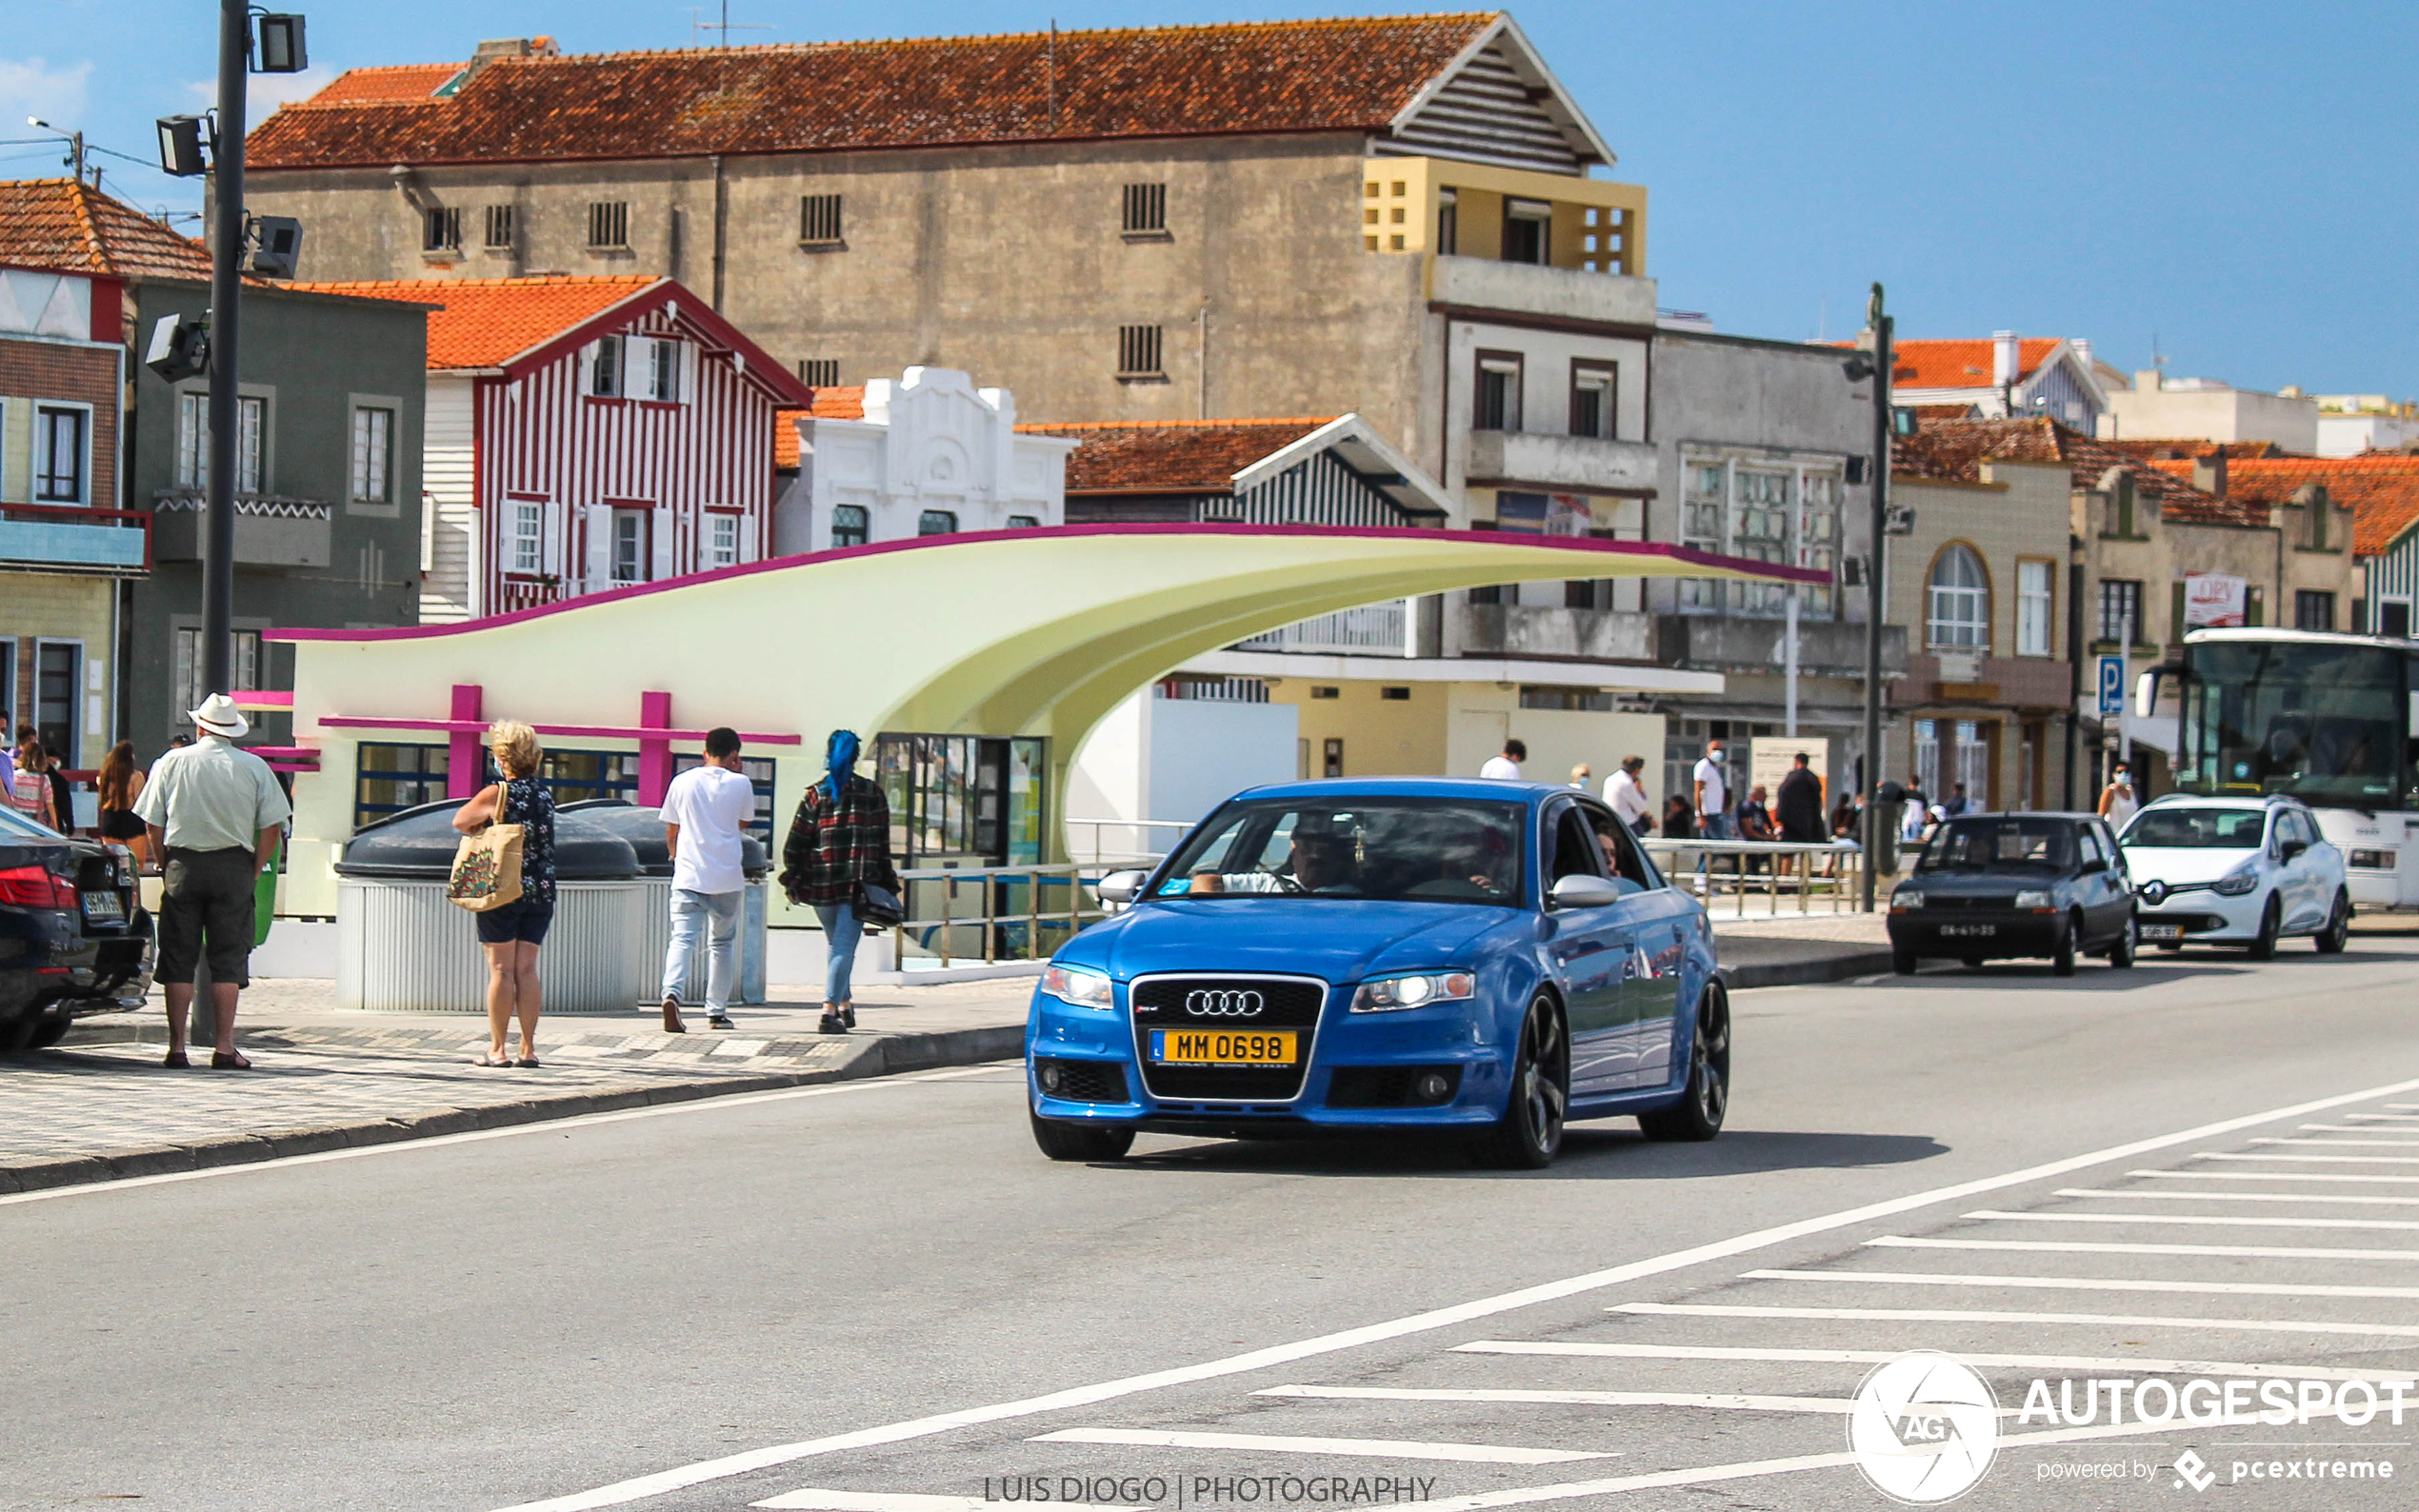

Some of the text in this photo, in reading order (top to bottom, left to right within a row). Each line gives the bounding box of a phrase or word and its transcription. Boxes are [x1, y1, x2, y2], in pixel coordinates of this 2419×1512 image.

[2104, 662, 2119, 708] P
[1153, 1048, 1161, 1057] L
[1177, 1035, 1283, 1060] MM 0698
